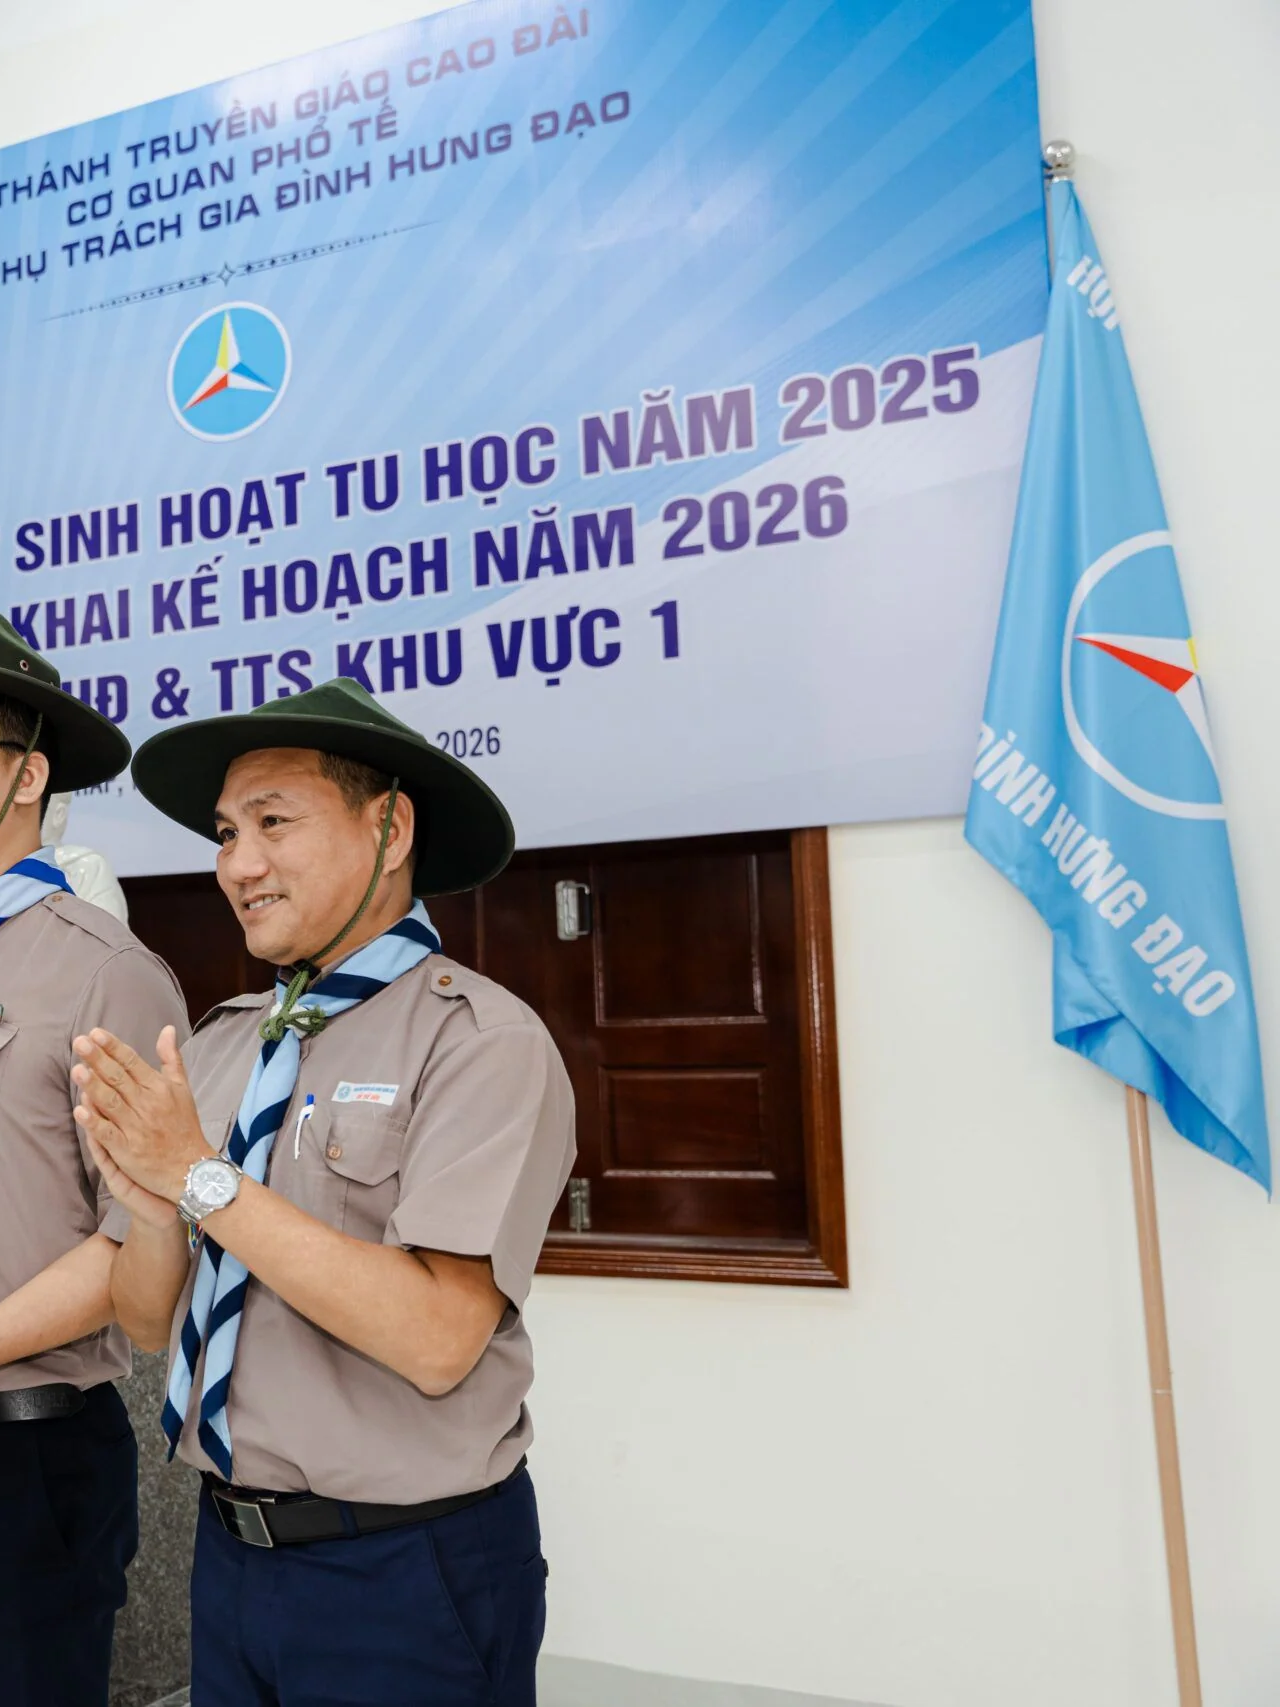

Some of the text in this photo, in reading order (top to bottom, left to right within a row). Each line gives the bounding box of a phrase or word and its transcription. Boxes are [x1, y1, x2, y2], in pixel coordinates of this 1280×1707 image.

[66, 96, 399, 227] CƠ QUAN PHỔ TẾ
[126, 98, 278, 169] TRUYỀN
[293, 67, 390, 121] GIÁO
[405, 37, 496, 88] CAO
[511, 5, 589, 57] ĐÀI
[61, 213, 182, 268] TRÁCH
[199, 193, 261, 232] GIA
[275, 160, 371, 212] ĐÌNH
[388, 122, 513, 182] HƯNG
[530, 90, 631, 142] ĐẠO
[15, 502, 139, 572] SINH
[160, 471, 305, 548] HOẠT
[325, 453, 400, 519] TU
[423, 426, 556, 505] HỌC
[581, 388, 754, 476] NĂM
[781, 346, 981, 443] 2025
[11, 588, 130, 651] KHAI
[152, 554, 226, 634] KẾ
[243, 536, 450, 621] HOẠCH
[474, 505, 634, 587] NĂM
[662, 475, 849, 560] 2026
[151, 667, 191, 720] &
[211, 649, 313, 713] TTS
[336, 626, 464, 696] KHU
[486, 603, 622, 687] VỰC
[650, 598, 681, 660] 1
[437, 725, 501, 759] 2026
[1041, 802, 1149, 930] HƯNG
[1131, 913, 1236, 1017] ĐẠO
